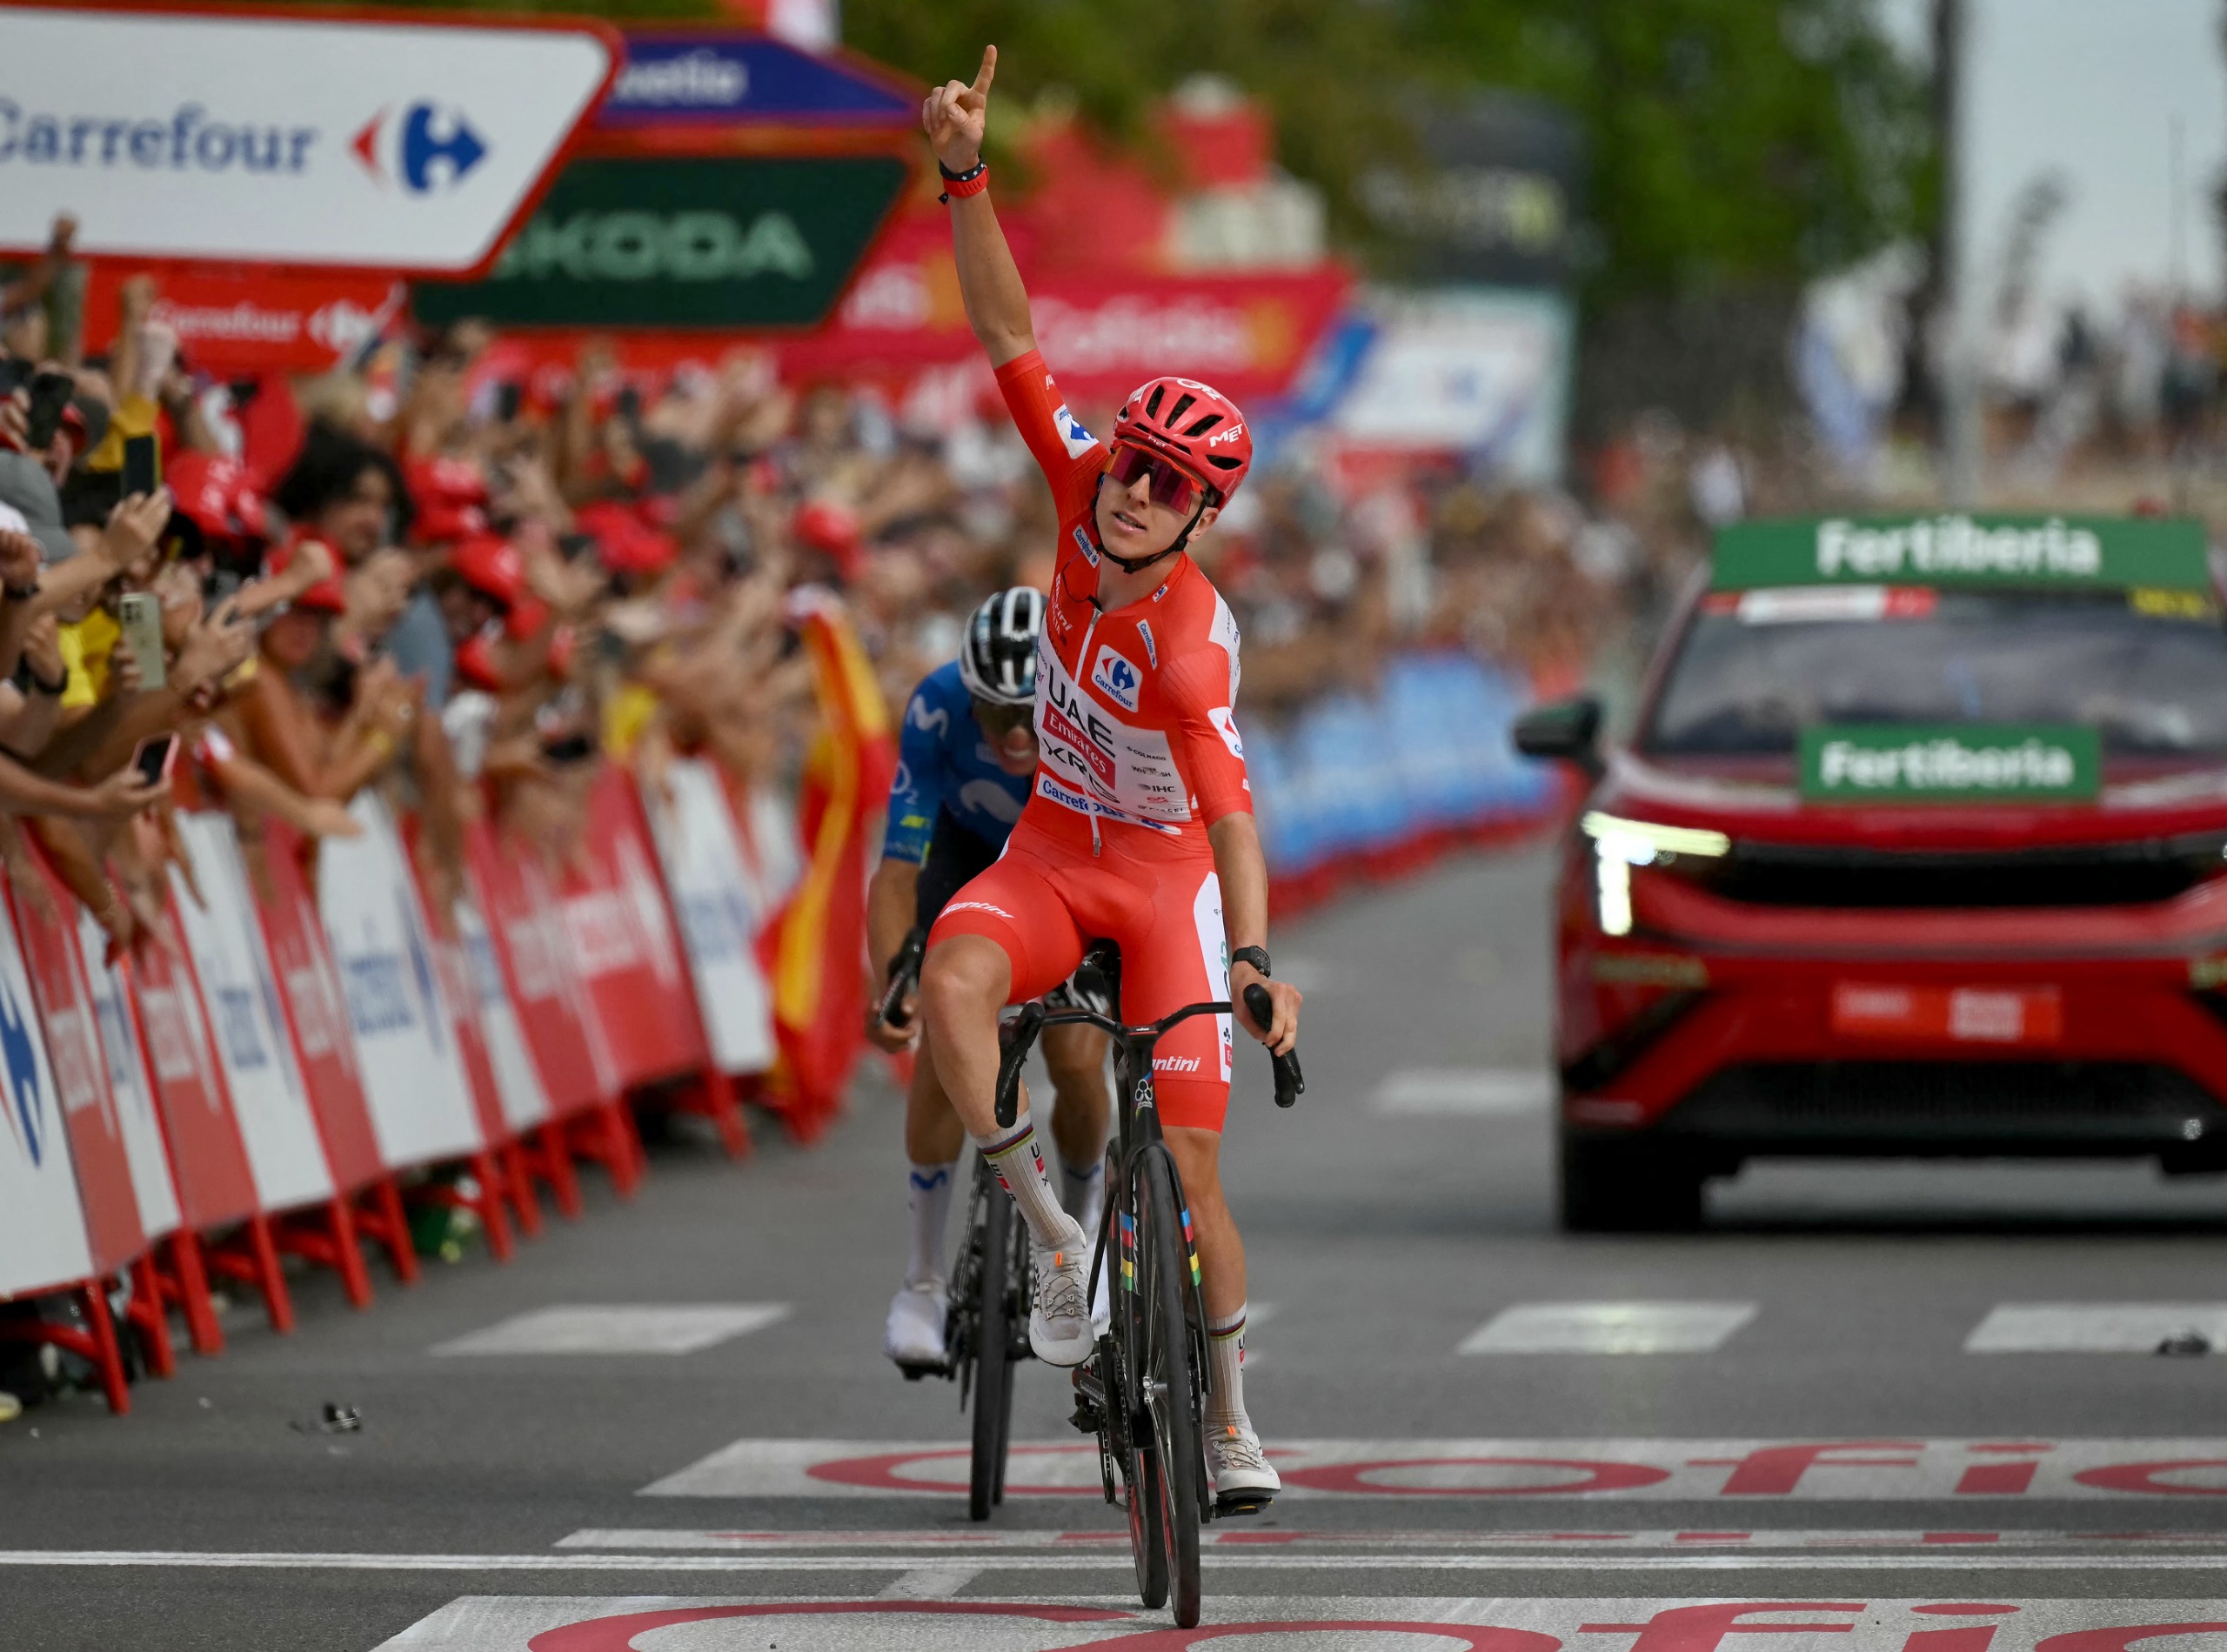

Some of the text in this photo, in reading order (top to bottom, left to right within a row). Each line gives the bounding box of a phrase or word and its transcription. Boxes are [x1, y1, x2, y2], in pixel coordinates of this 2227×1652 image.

[496, 212, 815, 280] KODA
[1147, 435, 1168, 448] MET
[1209, 423, 1243, 447] MET
[1075, 528, 1093, 558] Carrefour
[1816, 513, 2102, 578] Fertiberia
[1140, 623, 1154, 655] Carrefour
[1095, 674, 1134, 708] Carrefour
[1048, 665, 1116, 759] UAE
[1050, 716, 1107, 773] Emirates
[1133, 749, 1167, 761] COLNAGO
[1042, 738, 1120, 804] XRG
[1820, 739, 2075, 788] Fertiberia
[1043, 779, 1126, 819] Carrefour
[1153, 1056, 1201, 1072] ntini
